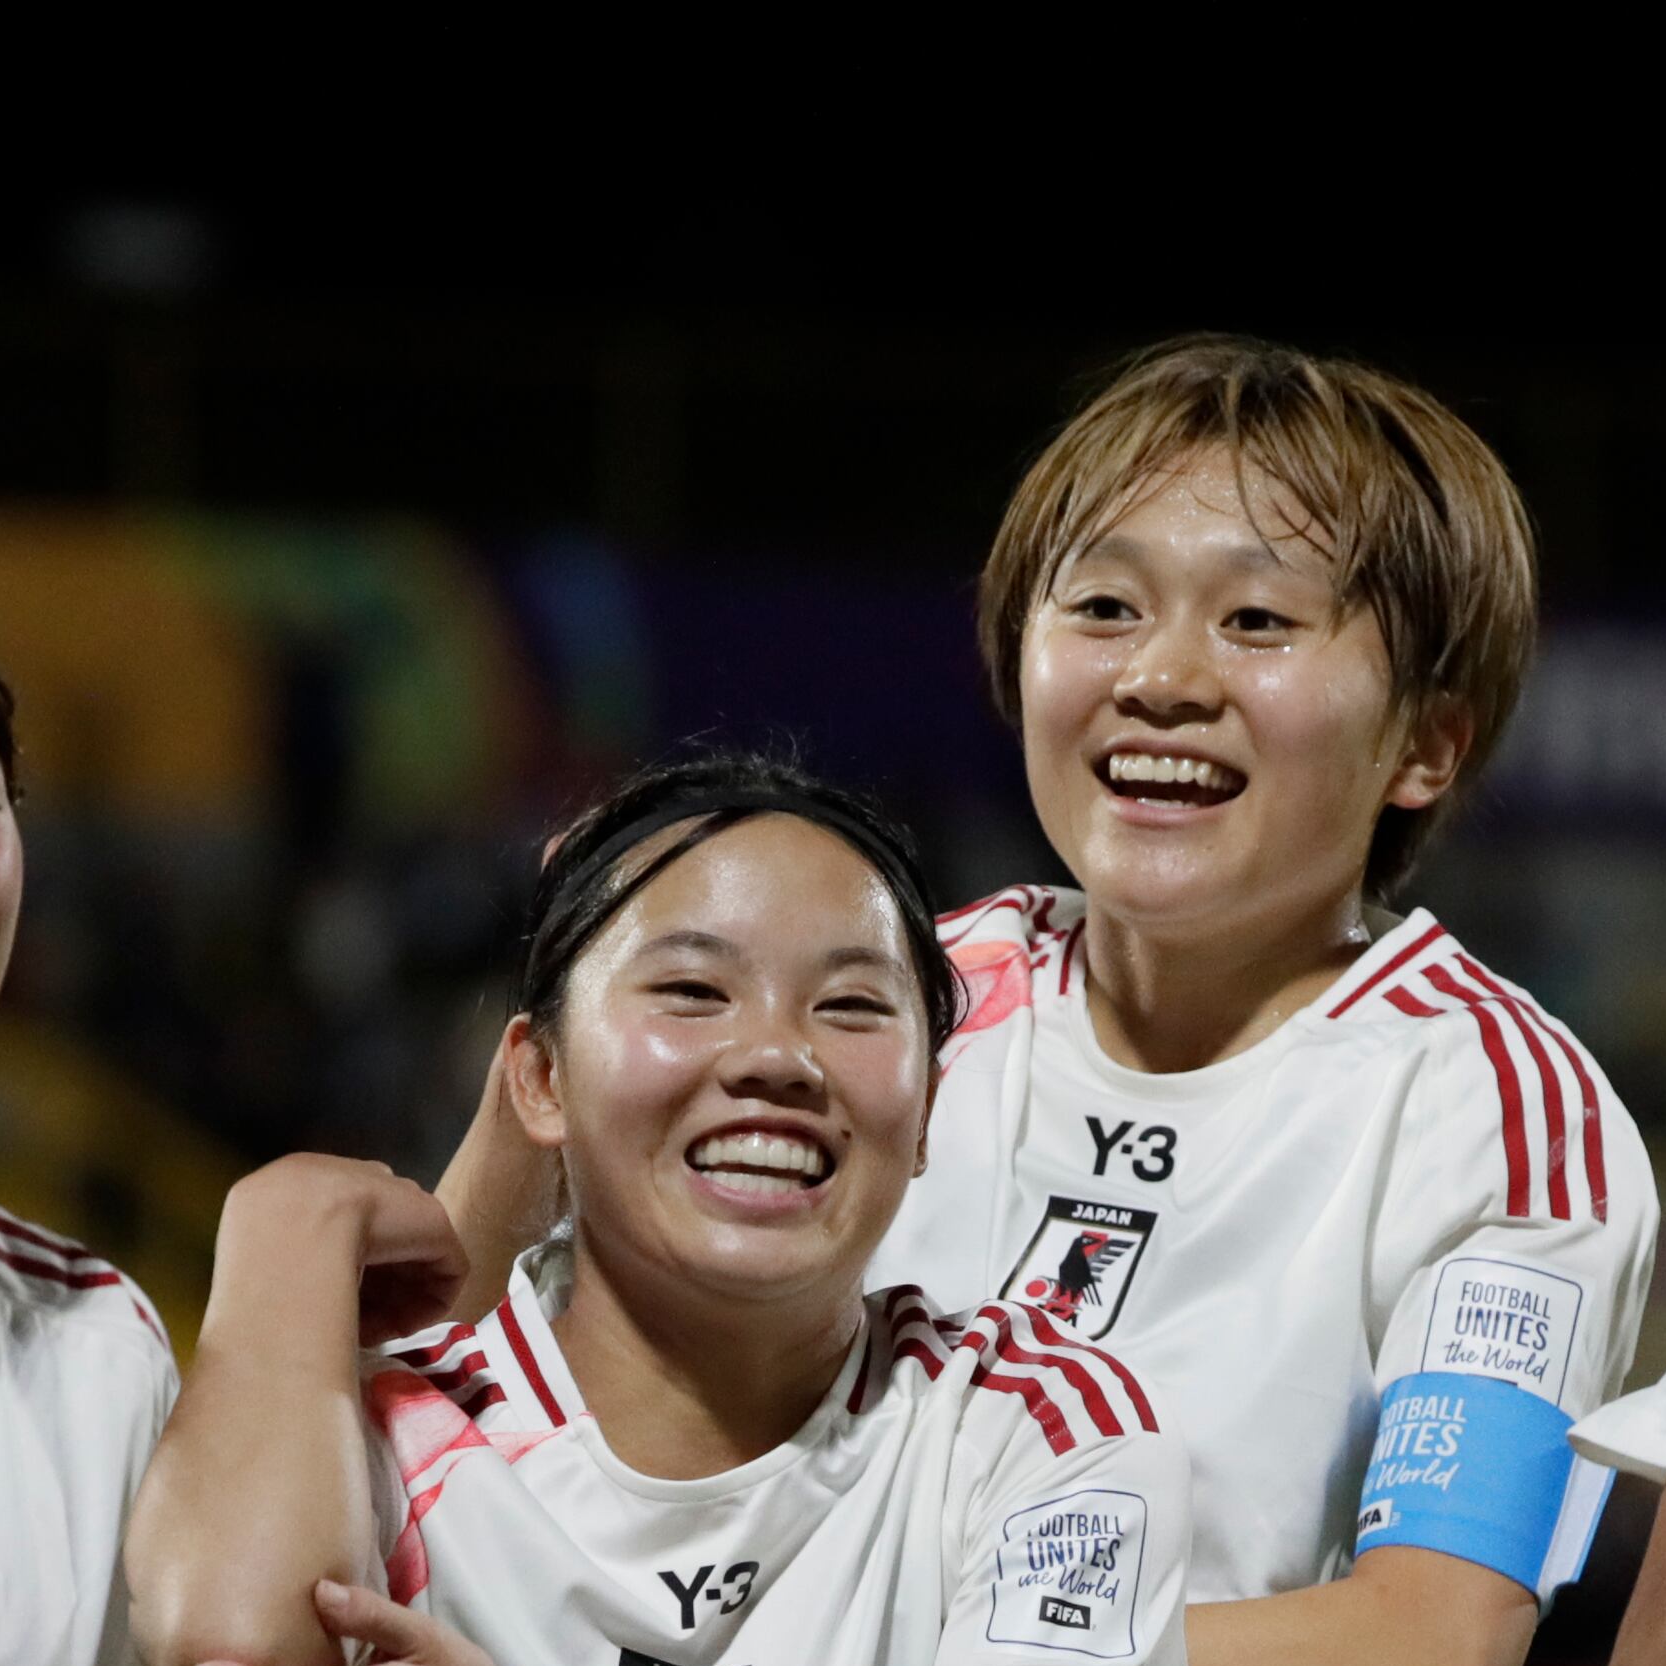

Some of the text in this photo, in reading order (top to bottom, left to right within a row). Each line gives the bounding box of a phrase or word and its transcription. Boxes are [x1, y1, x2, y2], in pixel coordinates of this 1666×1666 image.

[1085, 1115, 1177, 1182] Y-3
[1071, 1203, 1133, 1226] JAPAN
[1460, 1280, 1551, 1319] FOOTBALL
[1454, 1305, 1549, 1350] UNITES
[1444, 1338, 1550, 1383] the World
[1375, 1458, 1460, 1491] World
[1028, 1513, 1124, 1537] OOTBALL
[1027, 1537, 1121, 1572] UNITES
[656, 1560, 760, 1629] Y-3
[1058, 1565, 1120, 1606] World
[1046, 1602, 1085, 1625] FIFA
